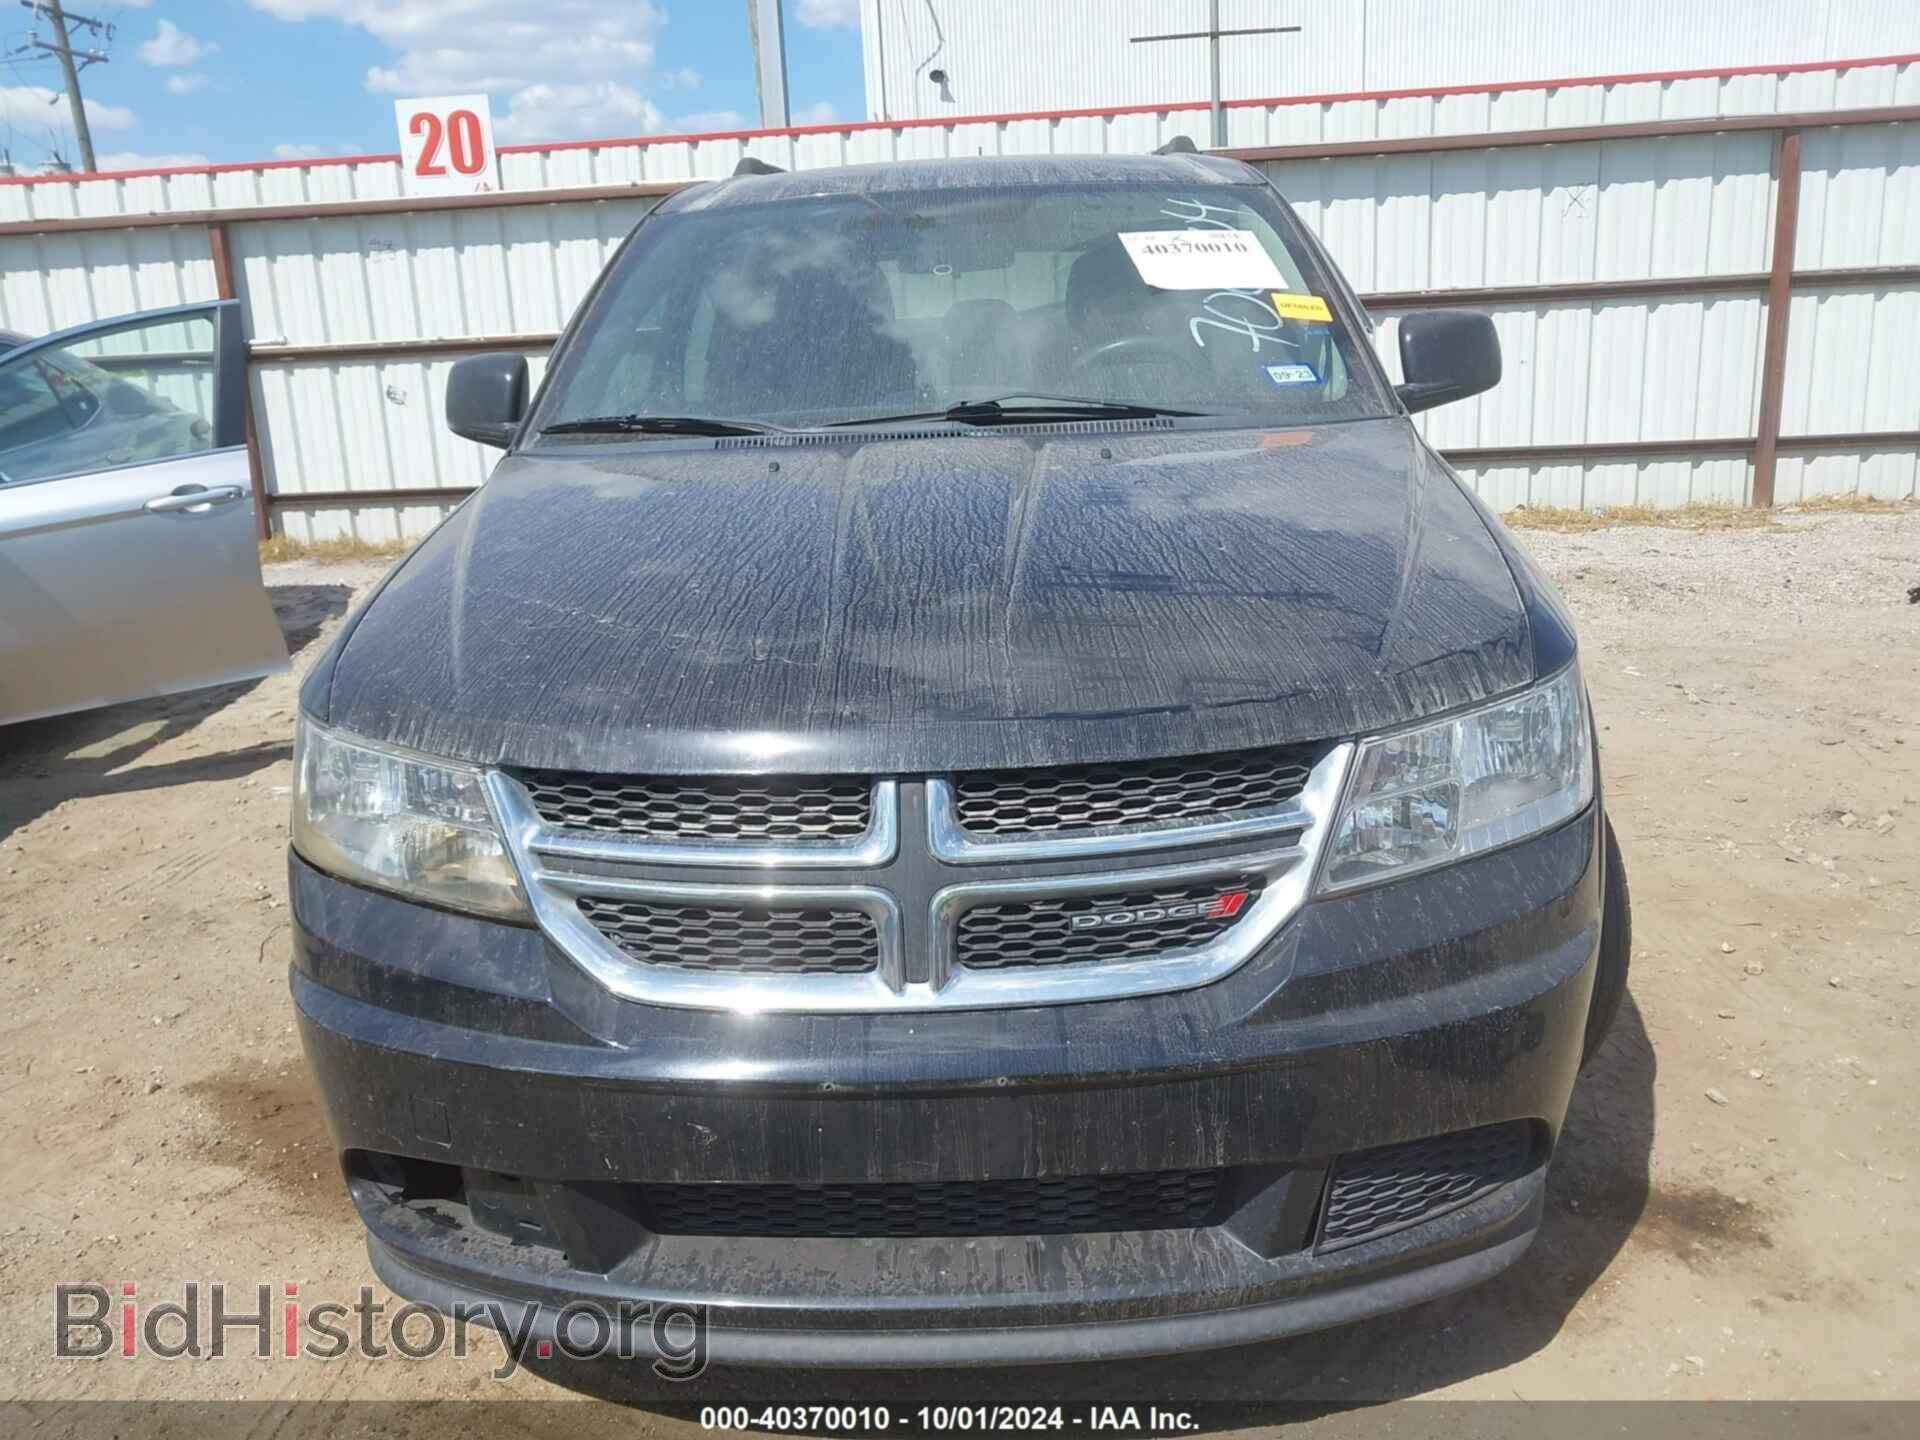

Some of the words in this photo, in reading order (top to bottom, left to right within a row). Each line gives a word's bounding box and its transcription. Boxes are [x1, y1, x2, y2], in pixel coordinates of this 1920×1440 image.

[408, 109, 486, 177] 20
[1142, 240, 1248, 256] 40370010
[1072, 902, 1225, 929] DODGE
